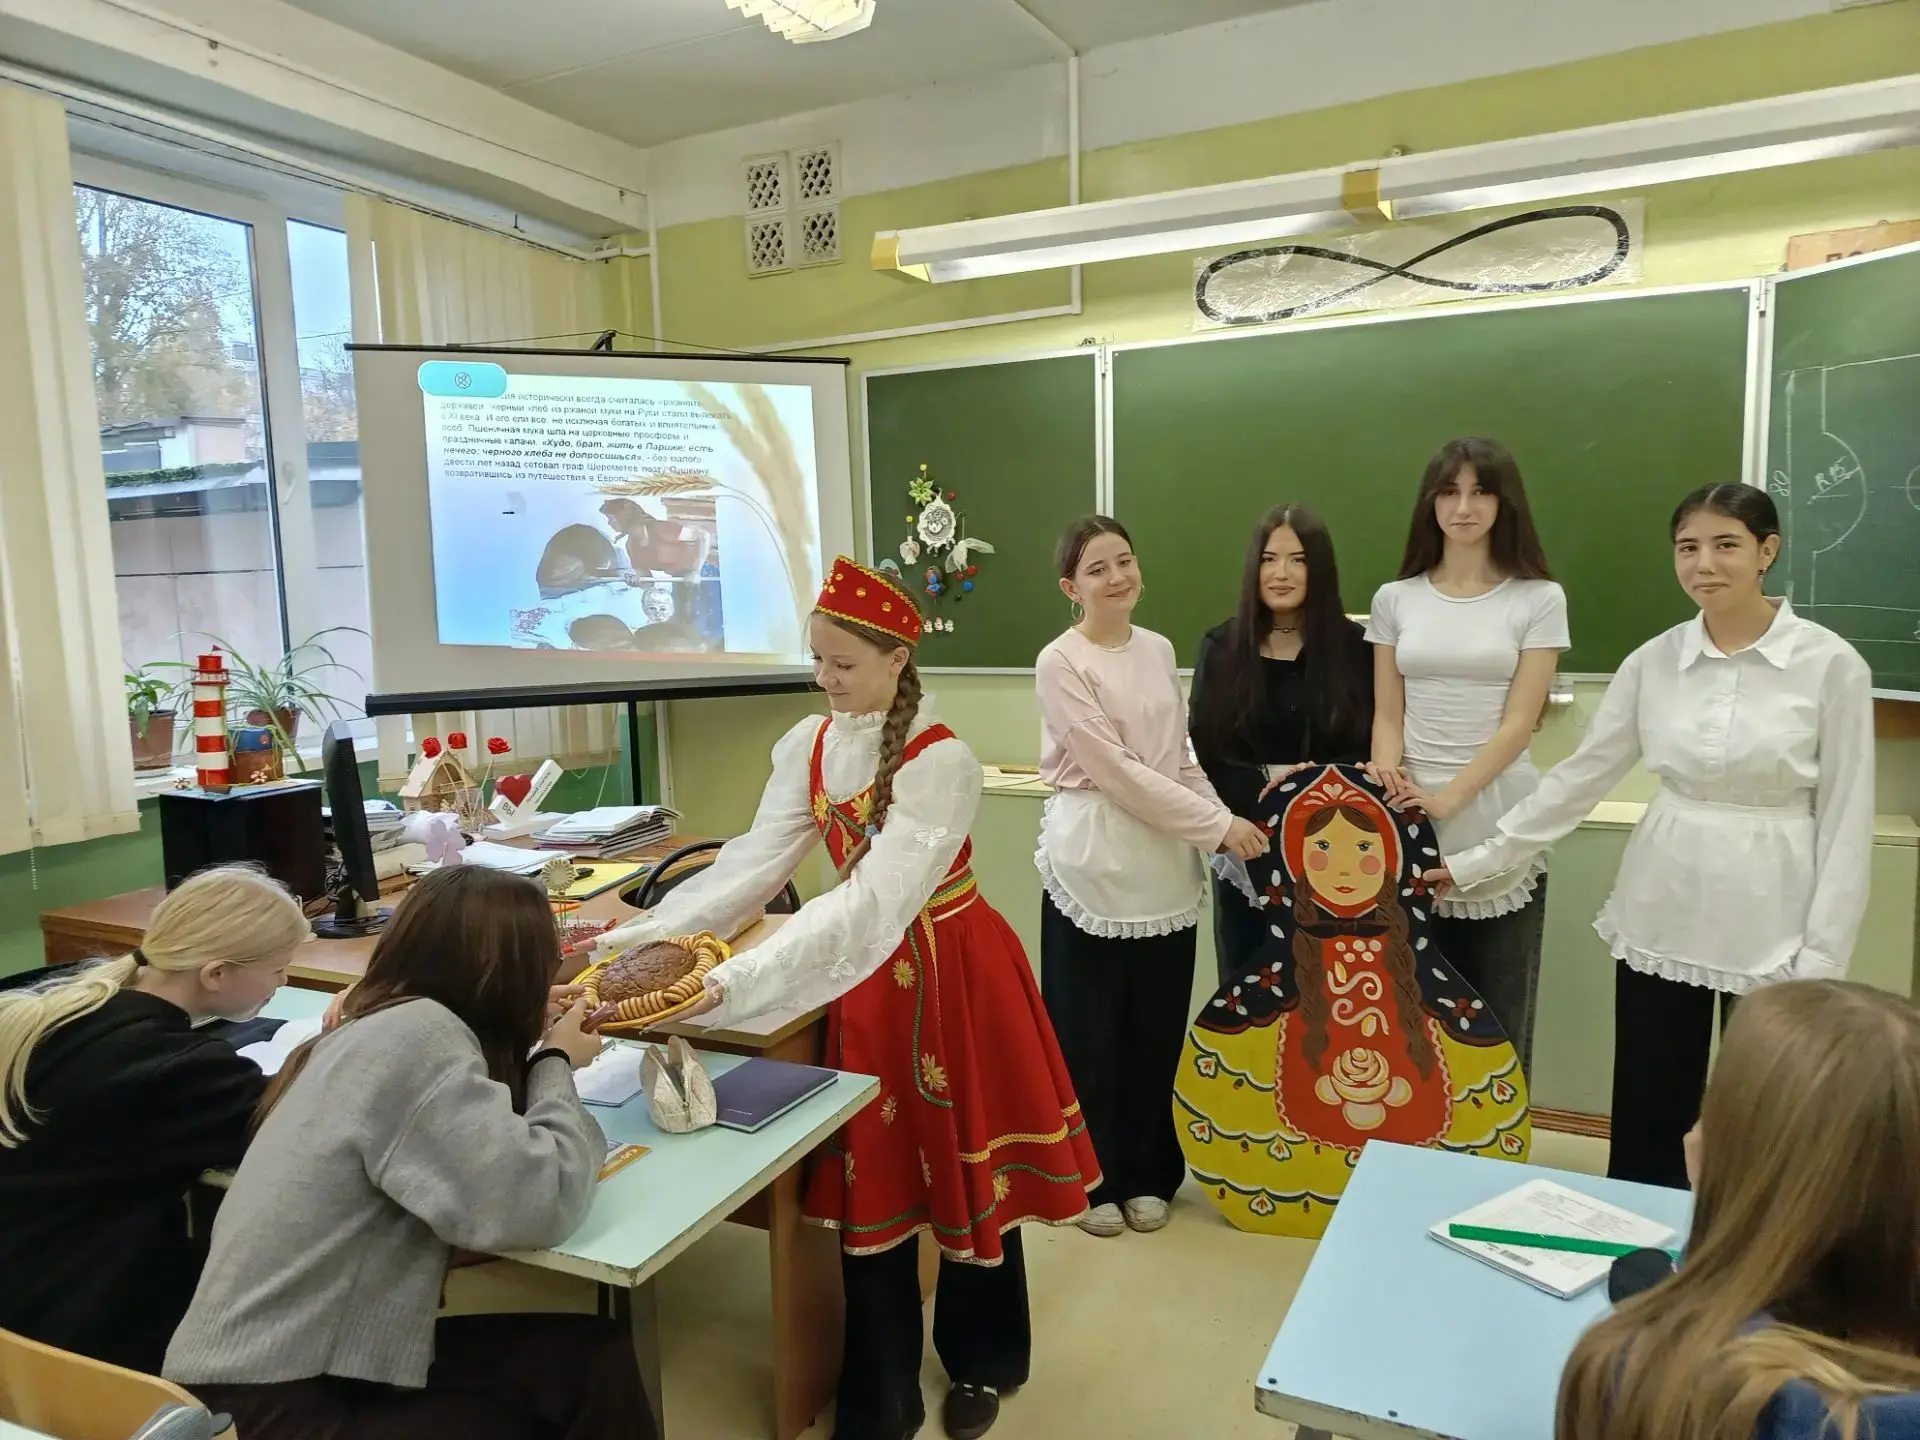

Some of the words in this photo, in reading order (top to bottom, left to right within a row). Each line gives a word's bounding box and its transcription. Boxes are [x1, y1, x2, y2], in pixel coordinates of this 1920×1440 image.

[518, 394, 574, 402] исторически
[576, 396, 606, 404] всегда
[608, 397, 655, 405] считалась
[491, 404, 525, 412] ерный
[600, 408, 622, 416] муки
[638, 408, 659, 418] Руси
[662, 410, 688, 418] стали
[486, 413, 493, 421] И
[512, 415, 529, 423] ели
[565, 418, 609, 426] исключая
[611, 417, 647, 428] богатых
[468, 424, 521, 434] Пшеничная
[523, 427, 545, 437] мука
[547, 428, 566, 436] шла
[582, 430, 630, 439] церковные
[633, 431, 680, 441] просфоры
[442, 435, 502, 445] праздничные
[606, 442, 634, 450] жить
[688, 445, 714, 453] есть
[482, 448, 523, 457] черного
[523, 449, 553, 458] хлеба
[555, 451, 567, 459] не
[652, 453, 667, 463] без
[670, 455, 702, 464] малого
[443, 458, 475, 467] двести
[495, 460, 521, 468] назад
[523, 461, 559, 469] сетовал
[562, 462, 584, 471] граф
[587, 462, 638, 473] Шереметев
[642, 465, 665, 475] поэту
[444, 469, 513, 479] возвратившись
[528, 472, 586, 481] путешествия
